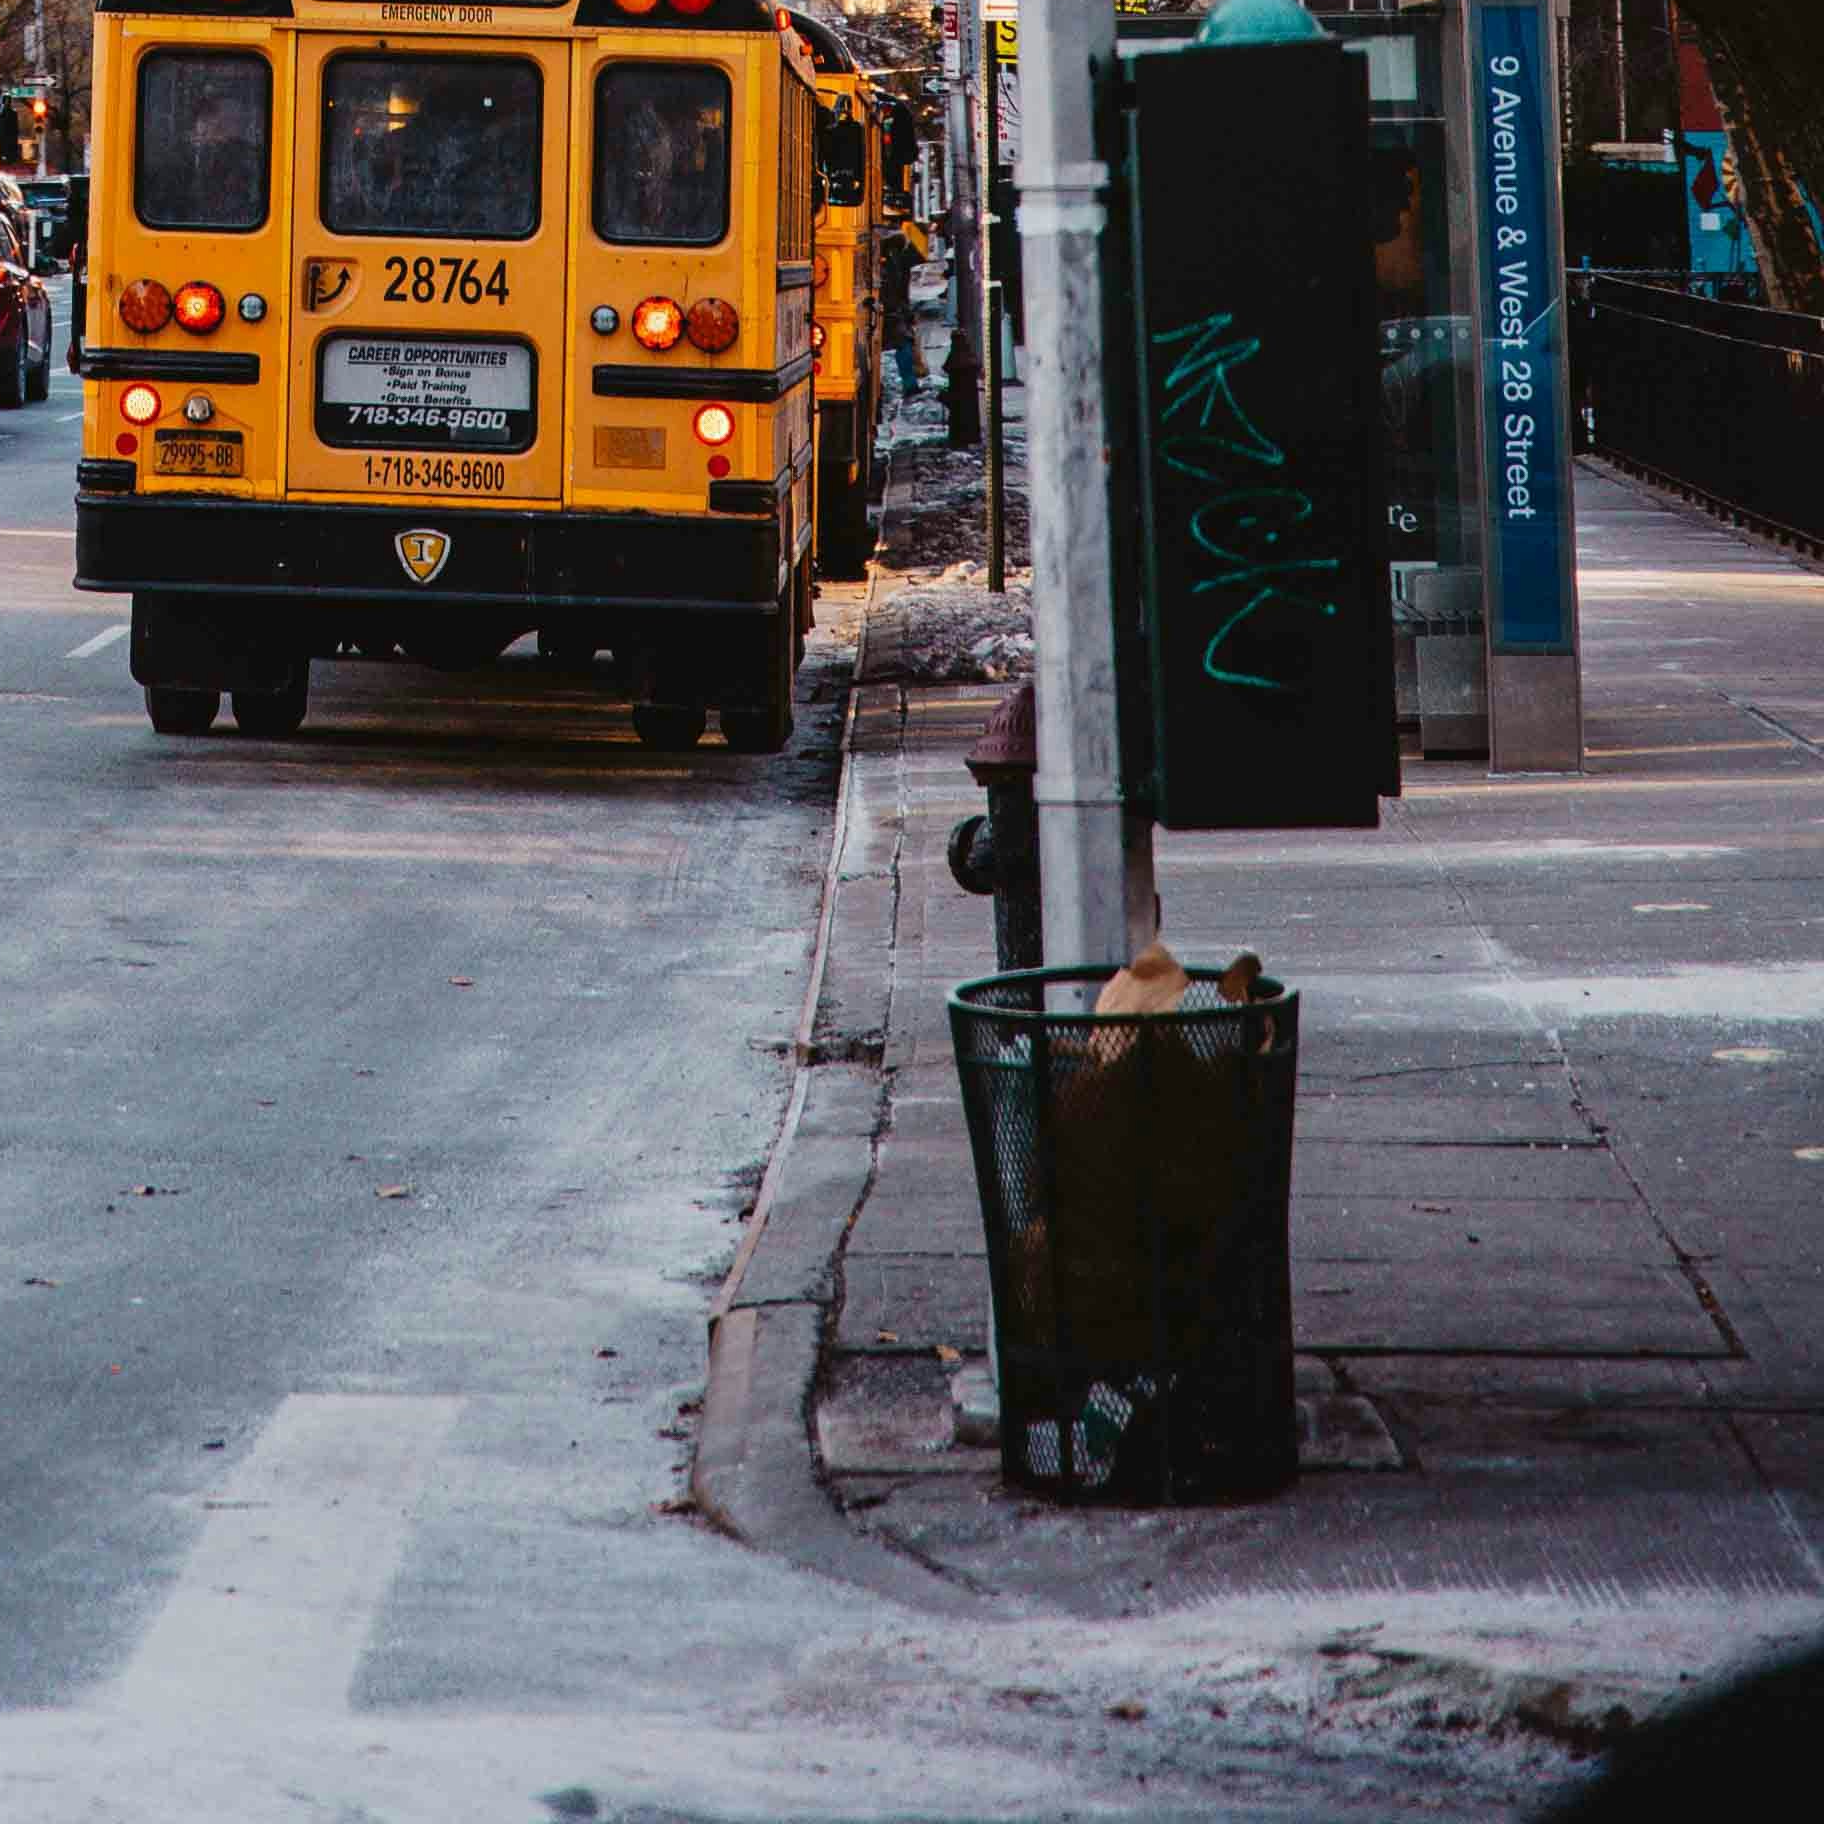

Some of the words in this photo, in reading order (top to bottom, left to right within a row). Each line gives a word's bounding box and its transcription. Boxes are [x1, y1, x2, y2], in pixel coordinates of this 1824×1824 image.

[381, 5, 455, 22] EMERGENCY
[459, 8, 493, 24] DOOR
[1491, 56, 1519, 76] 9
[1491, 87, 1522, 214] Avenue
[1498, 225, 1526, 251] &
[383, 255, 510, 306] 28764
[1500, 260, 1528, 349] West
[348, 346, 401, 362] CAREER
[404, 348, 507, 366] OPPORTUNITIES
[417, 368, 431, 377] on
[435, 368, 471, 378] Bonus
[1502, 360, 1533, 402] 28
[422, 381, 467, 394] Training
[424, 395, 472, 405] Benefits
[348, 406, 507, 429] 718-346-9600
[363, 456, 506, 492] 1-718-346-9600
[1504, 413, 1537, 519] Street
